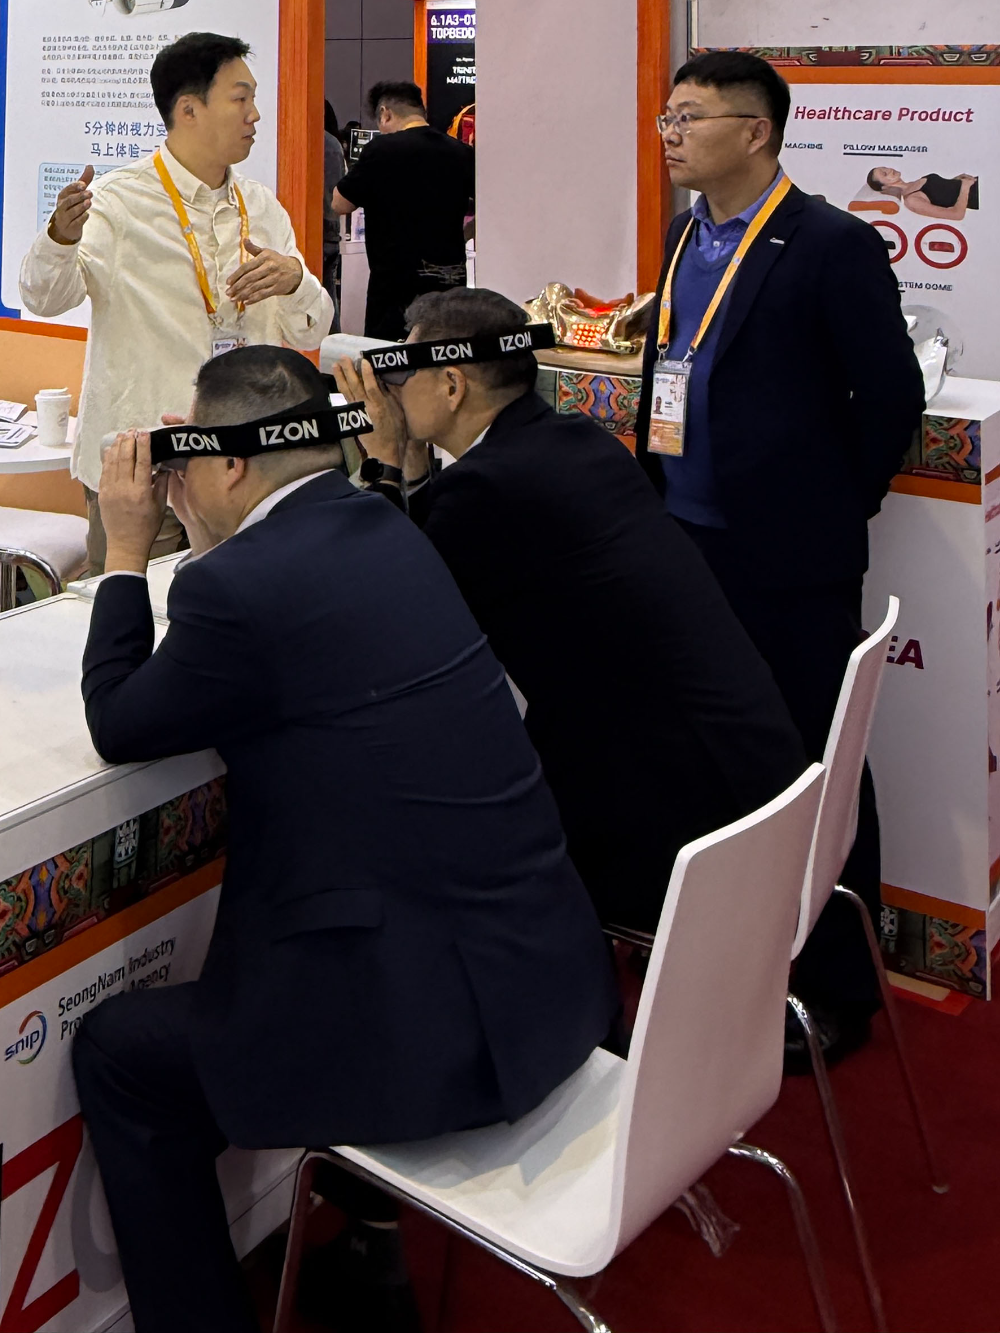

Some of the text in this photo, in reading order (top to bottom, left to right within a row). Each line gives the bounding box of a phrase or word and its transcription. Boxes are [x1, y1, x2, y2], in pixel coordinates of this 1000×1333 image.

[793, 105, 976, 124] Healthcare Product
[371, 330, 533, 369] IZON IZON IZON
[171, 408, 373, 452] IZON IZON IZON
[58, 936, 177, 1018] SeongNam Industry
[4, 1029, 41, 1062] snip
